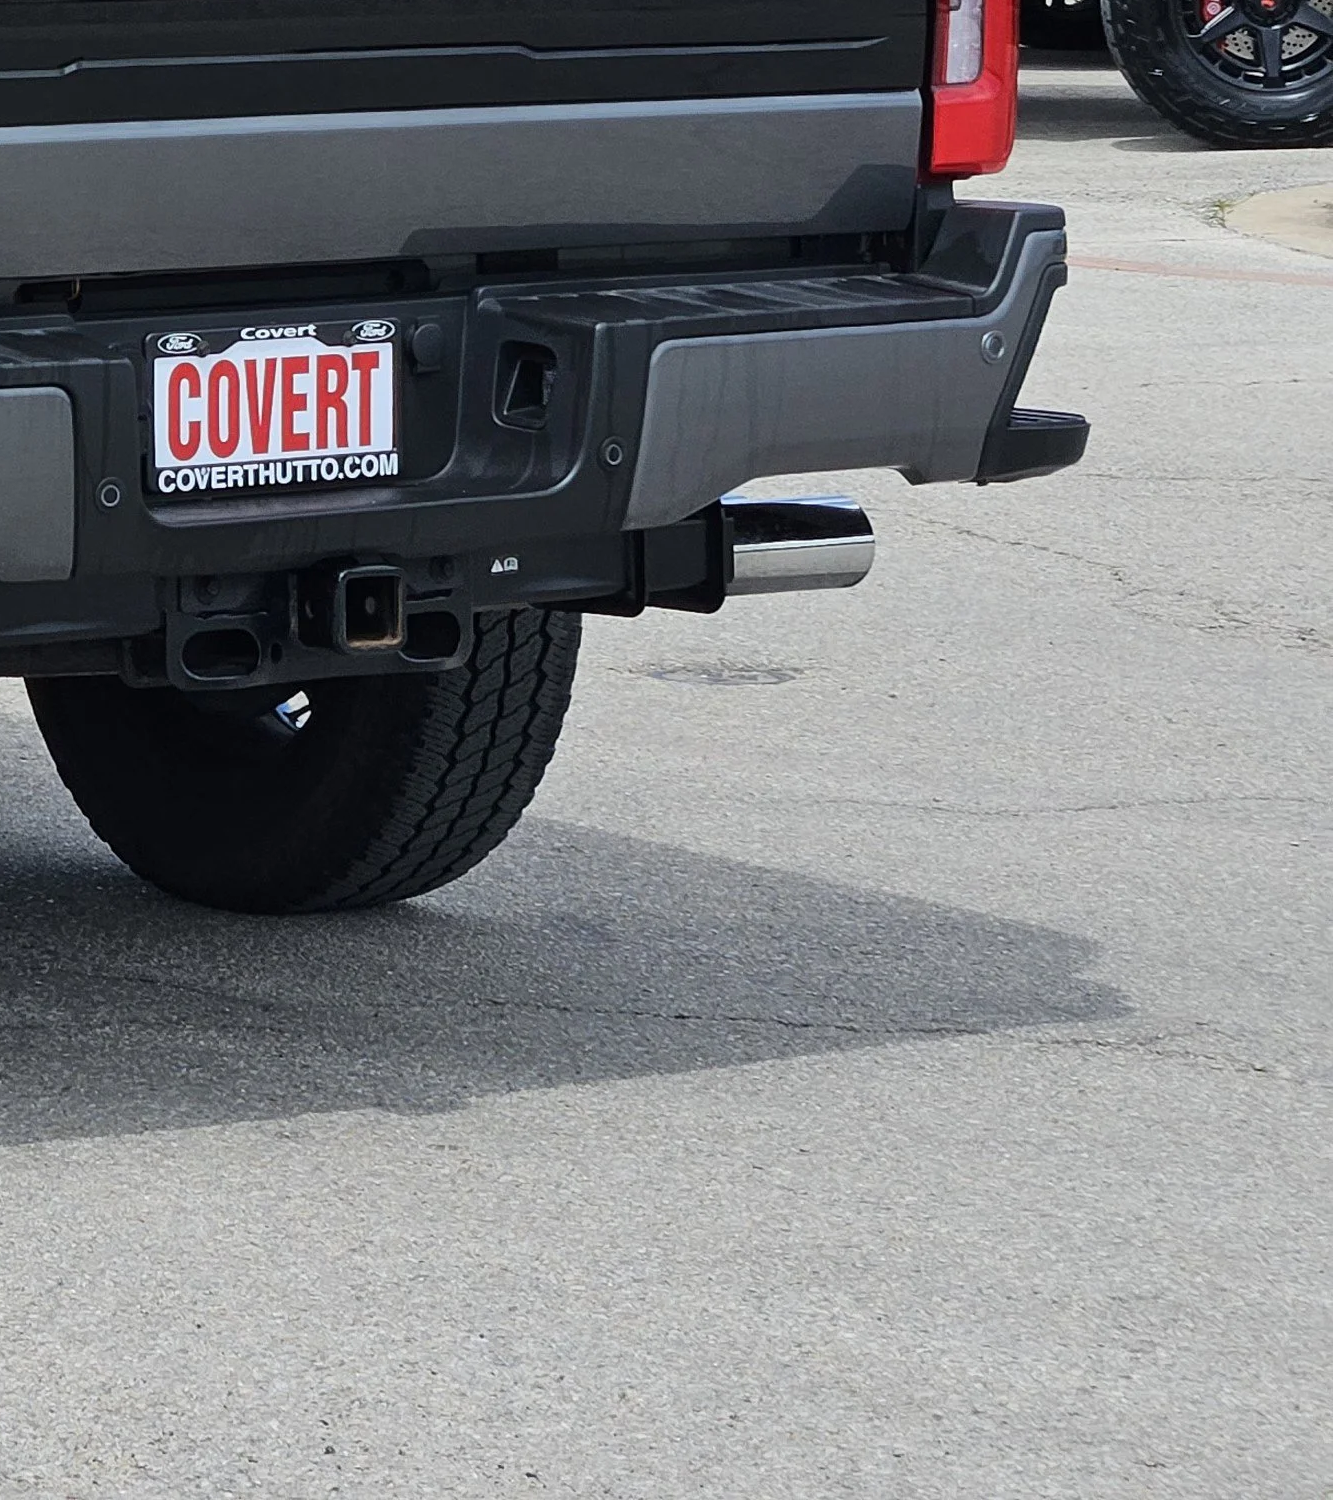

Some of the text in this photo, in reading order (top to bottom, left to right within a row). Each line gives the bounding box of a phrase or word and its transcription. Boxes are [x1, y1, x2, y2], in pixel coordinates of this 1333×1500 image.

[239, 323, 317, 341] Covert
[358, 322, 387, 338] Ford
[164, 335, 195, 352] Ford
[167, 350, 380, 462] COVERT
[158, 453, 399, 494] COVERTHUTTO.COM
